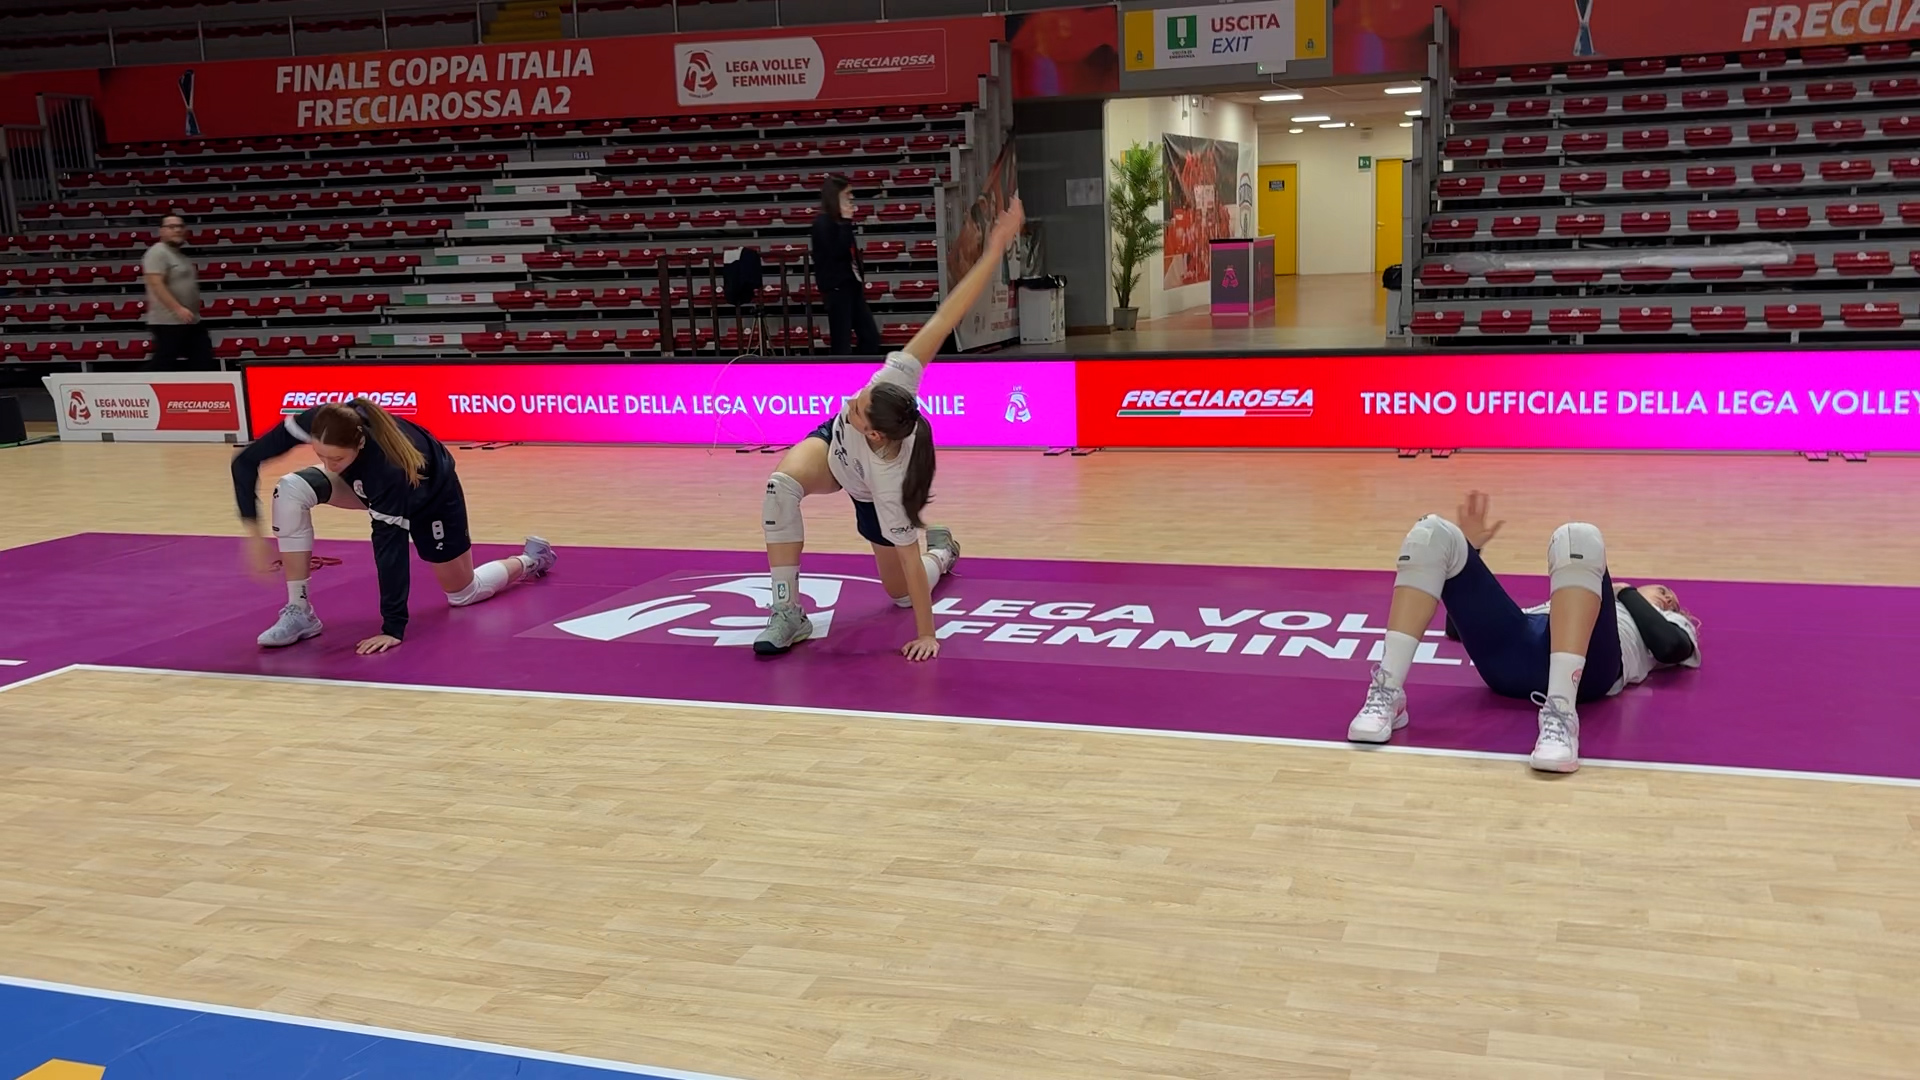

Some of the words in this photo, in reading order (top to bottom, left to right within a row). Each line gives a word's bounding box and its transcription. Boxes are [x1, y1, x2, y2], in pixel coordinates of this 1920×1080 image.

[1210, 13, 1281, 33] USCITA
[1211, 35, 1253, 54] EXIT
[276, 60, 381, 93] FINALE
[388, 54, 488, 87] COPPA
[497, 48, 595, 81] ITALIA
[725, 59, 758, 73] LEGA
[762, 57, 811, 72] VOLLEY
[836, 54, 936, 69] FRECCIAROSSA
[732, 72, 807, 88] FEMMINILE
[297, 88, 524, 128] FRECCIAROSSA
[530, 85, 572, 116] A2
[95, 398, 116, 408] LEGA
[118, 398, 150, 408] VOLLEY
[166, 401, 231, 409] FRECCIAROSSA
[448, 394, 516, 414] TRENO
[522, 394, 619, 415] UFFICIALE
[625, 394, 687, 415] DELLA
[692, 395, 747, 415] LEGA
[752, 395, 835, 415] VOLLEY
[1121, 389, 1314, 407] FRECCIAROSSA
[1361, 391, 1457, 415] TRENO
[1466, 391, 1608, 415] UFFICIALE
[1617, 390, 1708, 415] DELLA
[1717, 390, 1799, 415] LEGA
[100, 409, 149, 419] FEMMINILE
[432, 520, 445, 540] 8
[931, 597, 1154, 624] LEGA
[936, 620, 1475, 667] FEMMINIL
